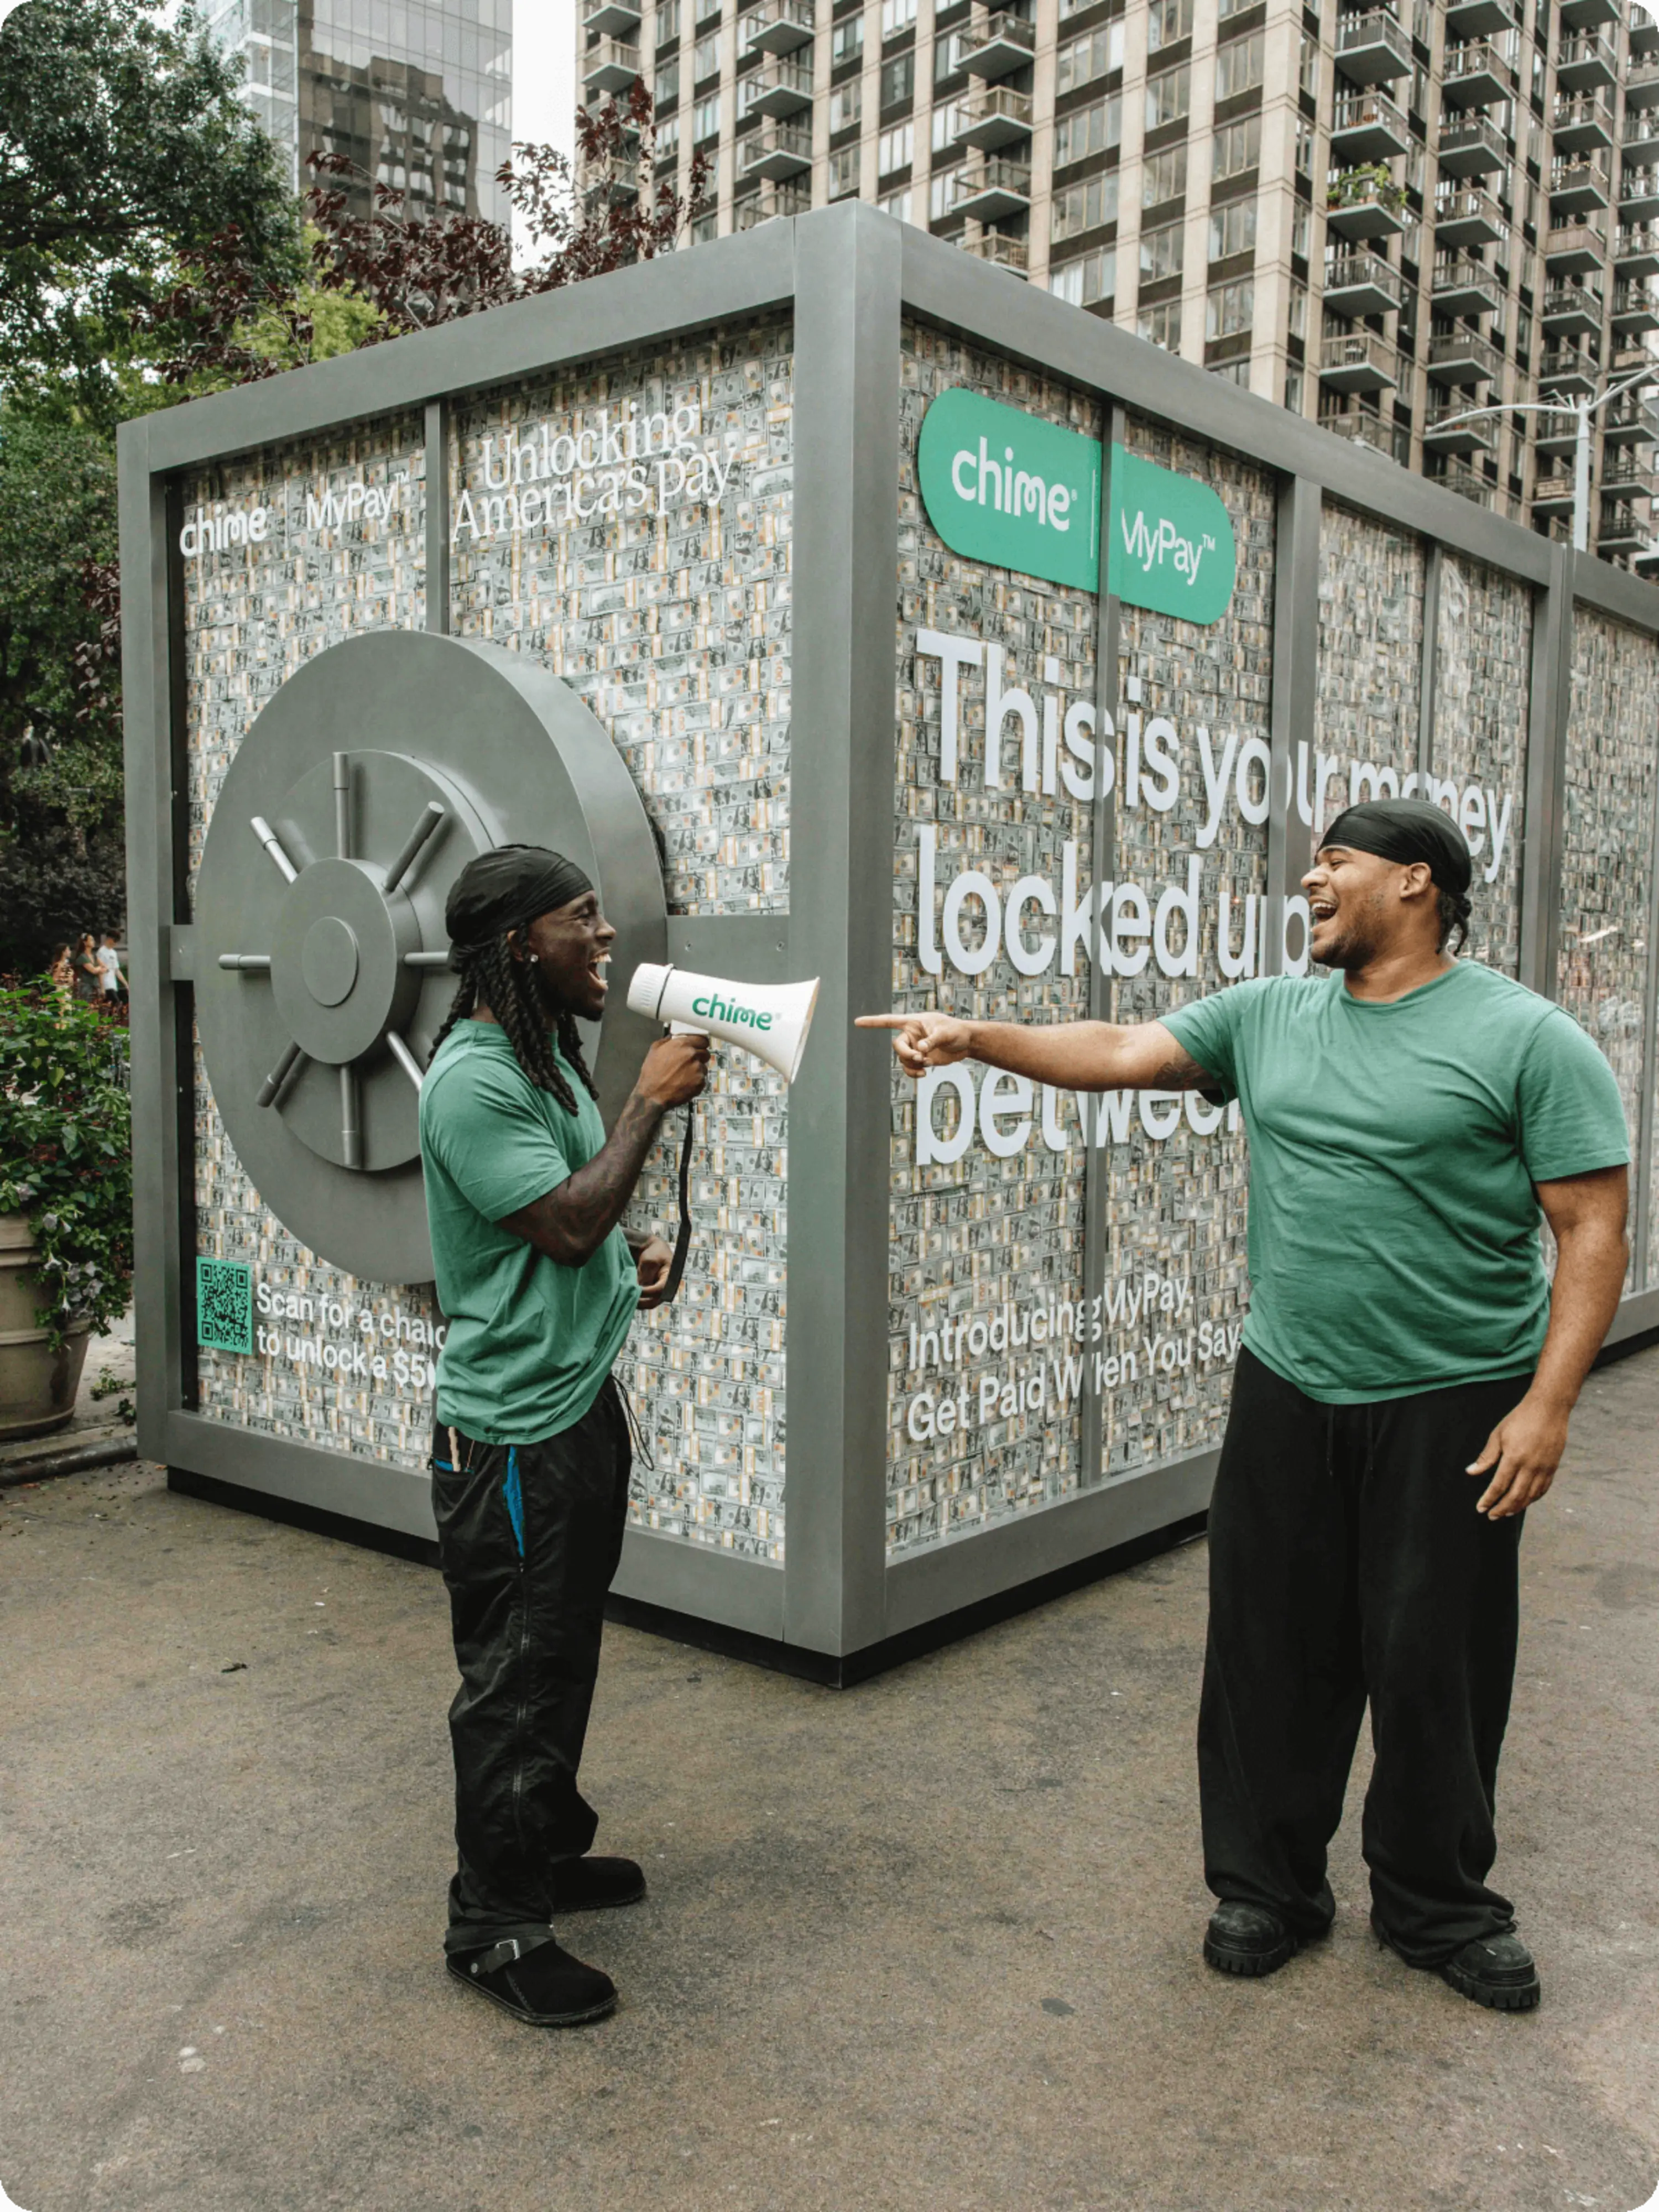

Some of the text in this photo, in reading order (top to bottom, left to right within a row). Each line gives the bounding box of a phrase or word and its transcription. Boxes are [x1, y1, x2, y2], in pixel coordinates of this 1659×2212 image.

[482, 402, 701, 491] Unlocking
[452, 447, 737, 543] America's pay
[916, 628, 1115, 801] This
[1126, 676, 1181, 812] is
[1196, 727, 1338, 848] your
[918, 824, 1201, 978] locked
[916, 1061, 1239, 1166] betwee
[256, 1282, 314, 1322] Scan
[319, 1292, 352, 1328] for
[359, 1308, 375, 1336] a
[256, 1325, 280, 1357] to
[286, 1333, 368, 1376] unlock
[372, 1355, 387, 1381] a
[909, 1293, 1103, 1371] Introducing
[908, 1385, 971, 1442] Get
[979, 1363, 1046, 1425] Paid
[1142, 1332, 1191, 1376] You
